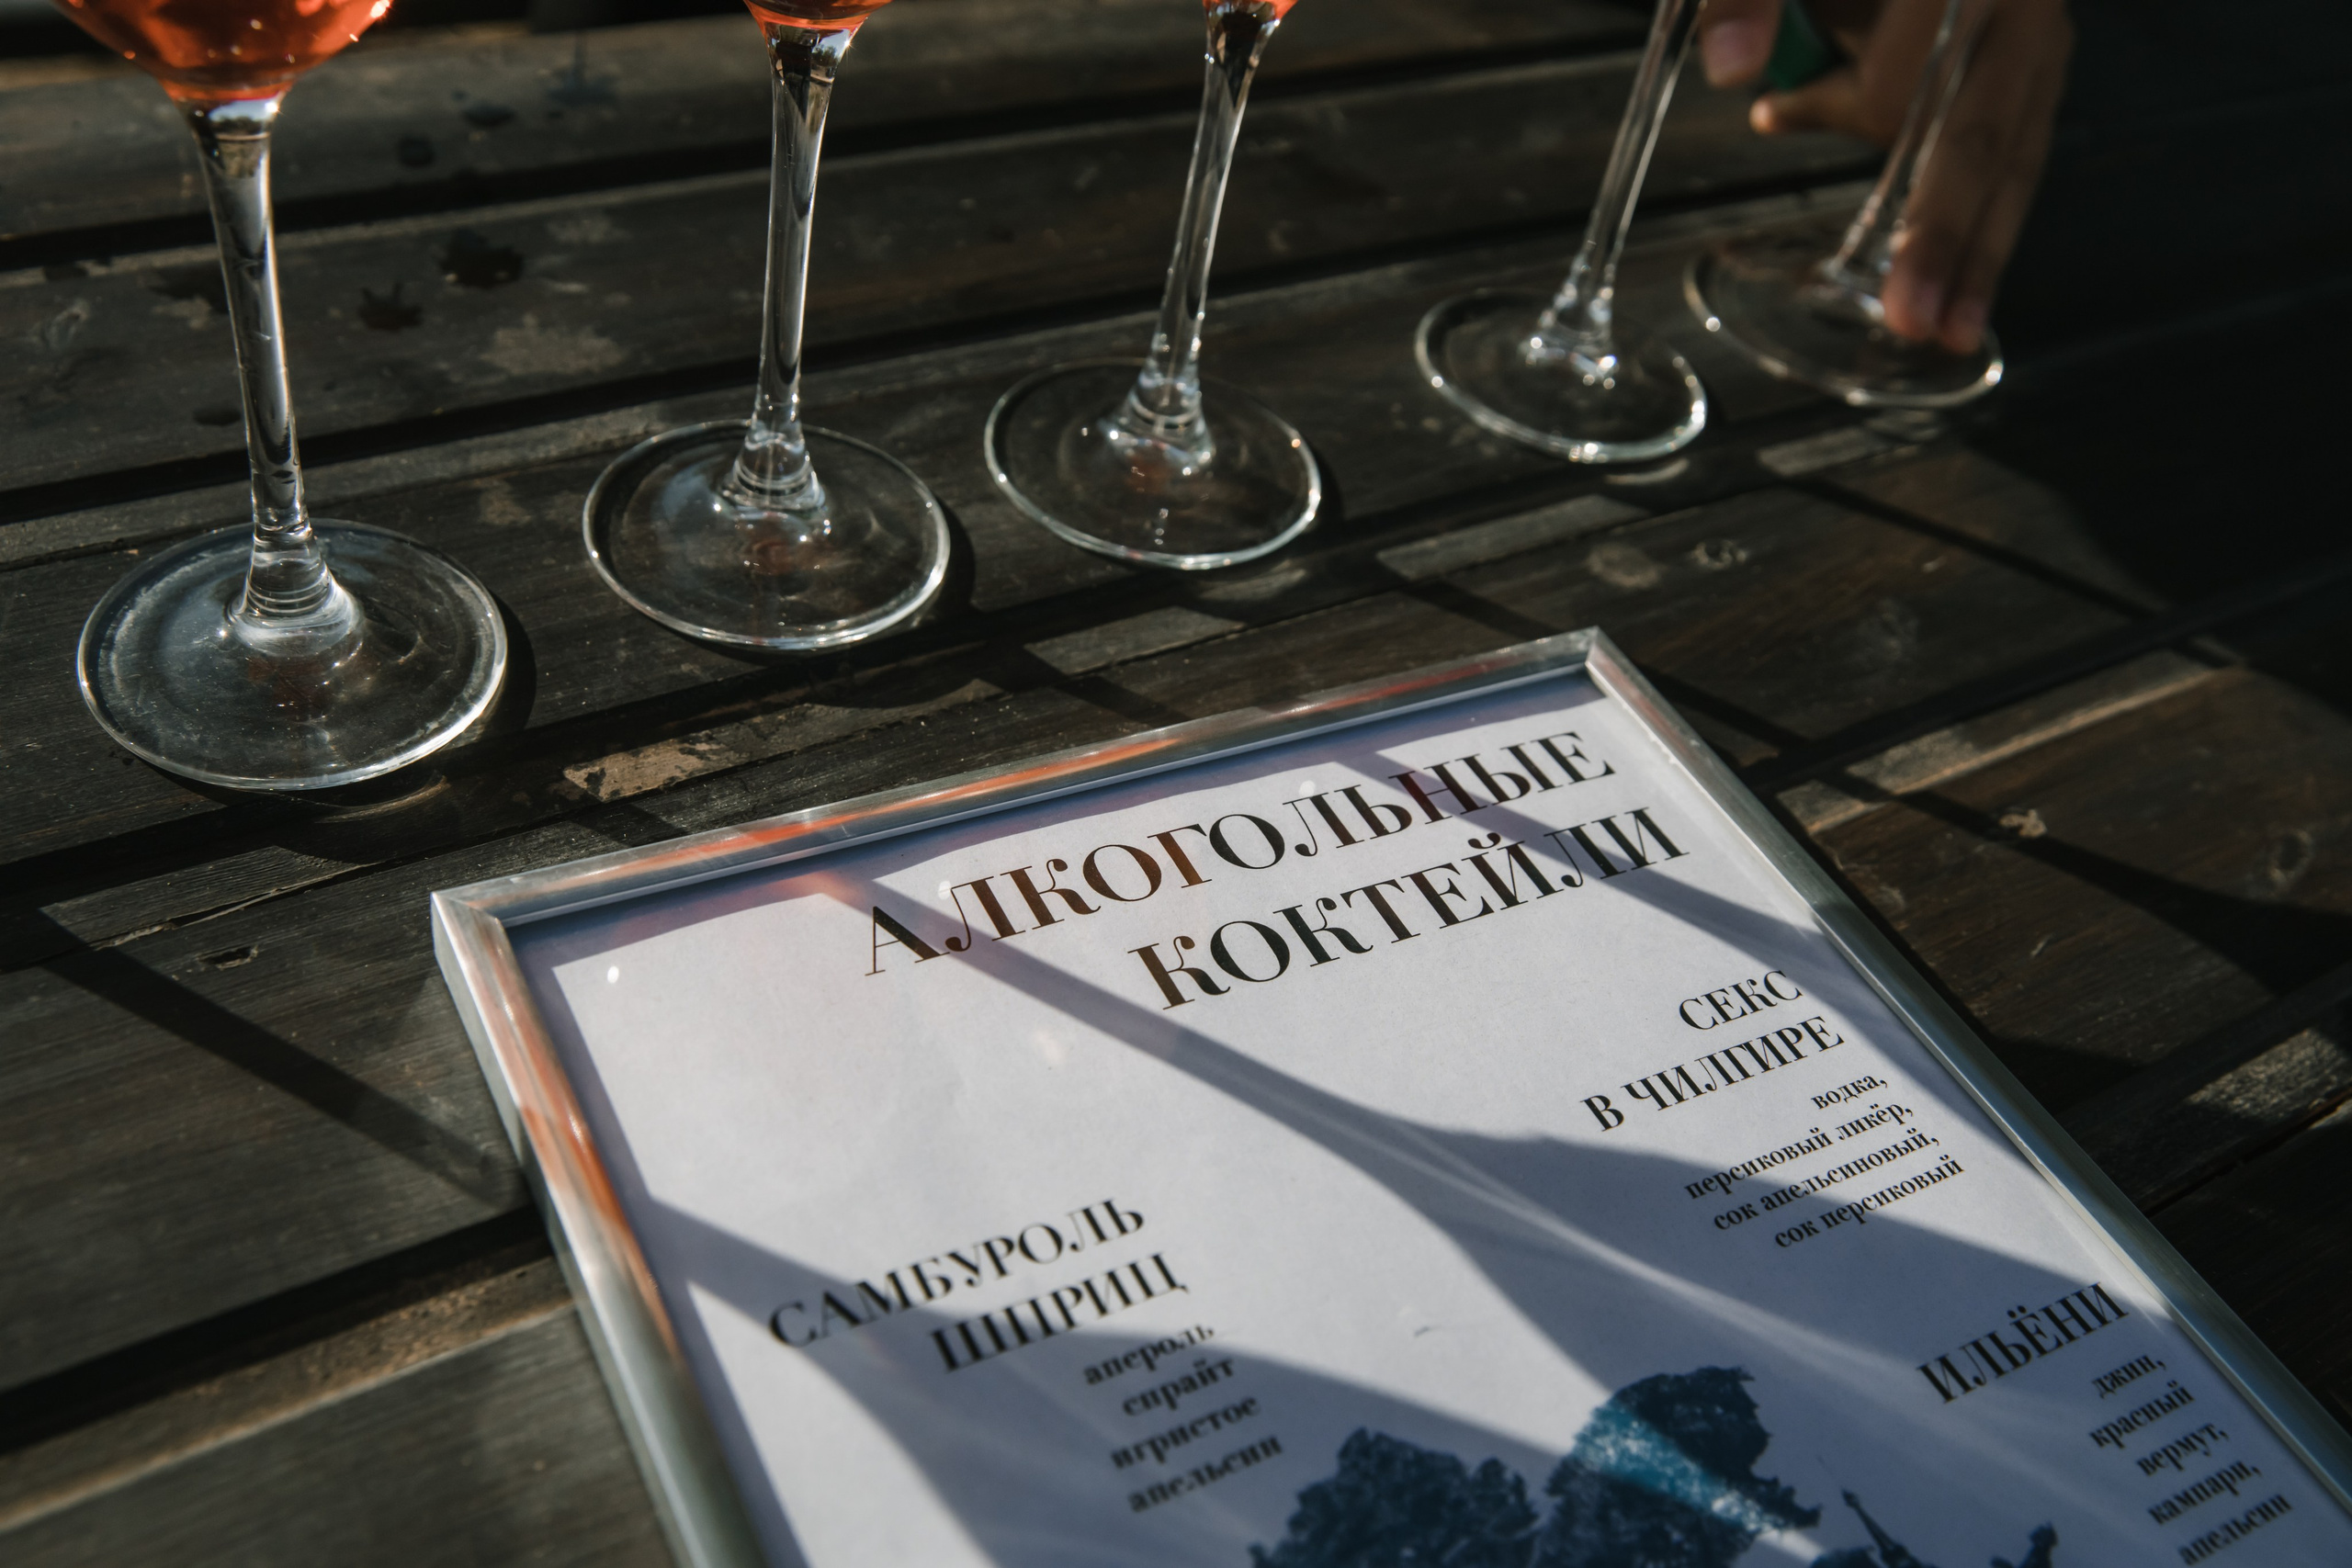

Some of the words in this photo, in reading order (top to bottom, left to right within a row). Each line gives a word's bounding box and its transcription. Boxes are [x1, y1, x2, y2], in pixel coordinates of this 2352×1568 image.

[865, 729, 1615, 976] АЛКОГОЛЬНЫЕ
[1126, 806, 1690, 1010] КОКТЕЙЛИ
[1679, 970, 1803, 1031] СЕКС
[1580, 1095, 1624, 1132] В
[1621, 1016, 1844, 1111] ЧИЛГИРЕ
[1811, 1072, 1888, 1110] водка,
[1684, 1126, 1834, 1200] персиковый
[1836, 1102, 1913, 1141] ликёр,
[1713, 1205, 1759, 1231] сок
[1759, 1127, 1939, 1212] апельсиновый,
[1774, 1217, 1820, 1248] сок
[1820, 1154, 1964, 1231] персиковый
[768, 1199, 1146, 1348] САМБУРОЛЬ
[929, 1251, 1189, 1373] ШПРИЦ
[1917, 1282, 2130, 1404] ИЛЬЁНИ
[1122, 1358, 1234, 1416] спрайт
[2090, 1352, 2166, 1399] джин,
[1111, 1396, 1261, 1470] игристое
[2088, 1381, 2194, 1450] красный
[2135, 1423, 2230, 1477] вермут,
[1127, 1437, 1283, 1513] апельсин
[2146, 1460, 2262, 1525] кампари,
[2177, 1494, 2293, 1566] апельсин
